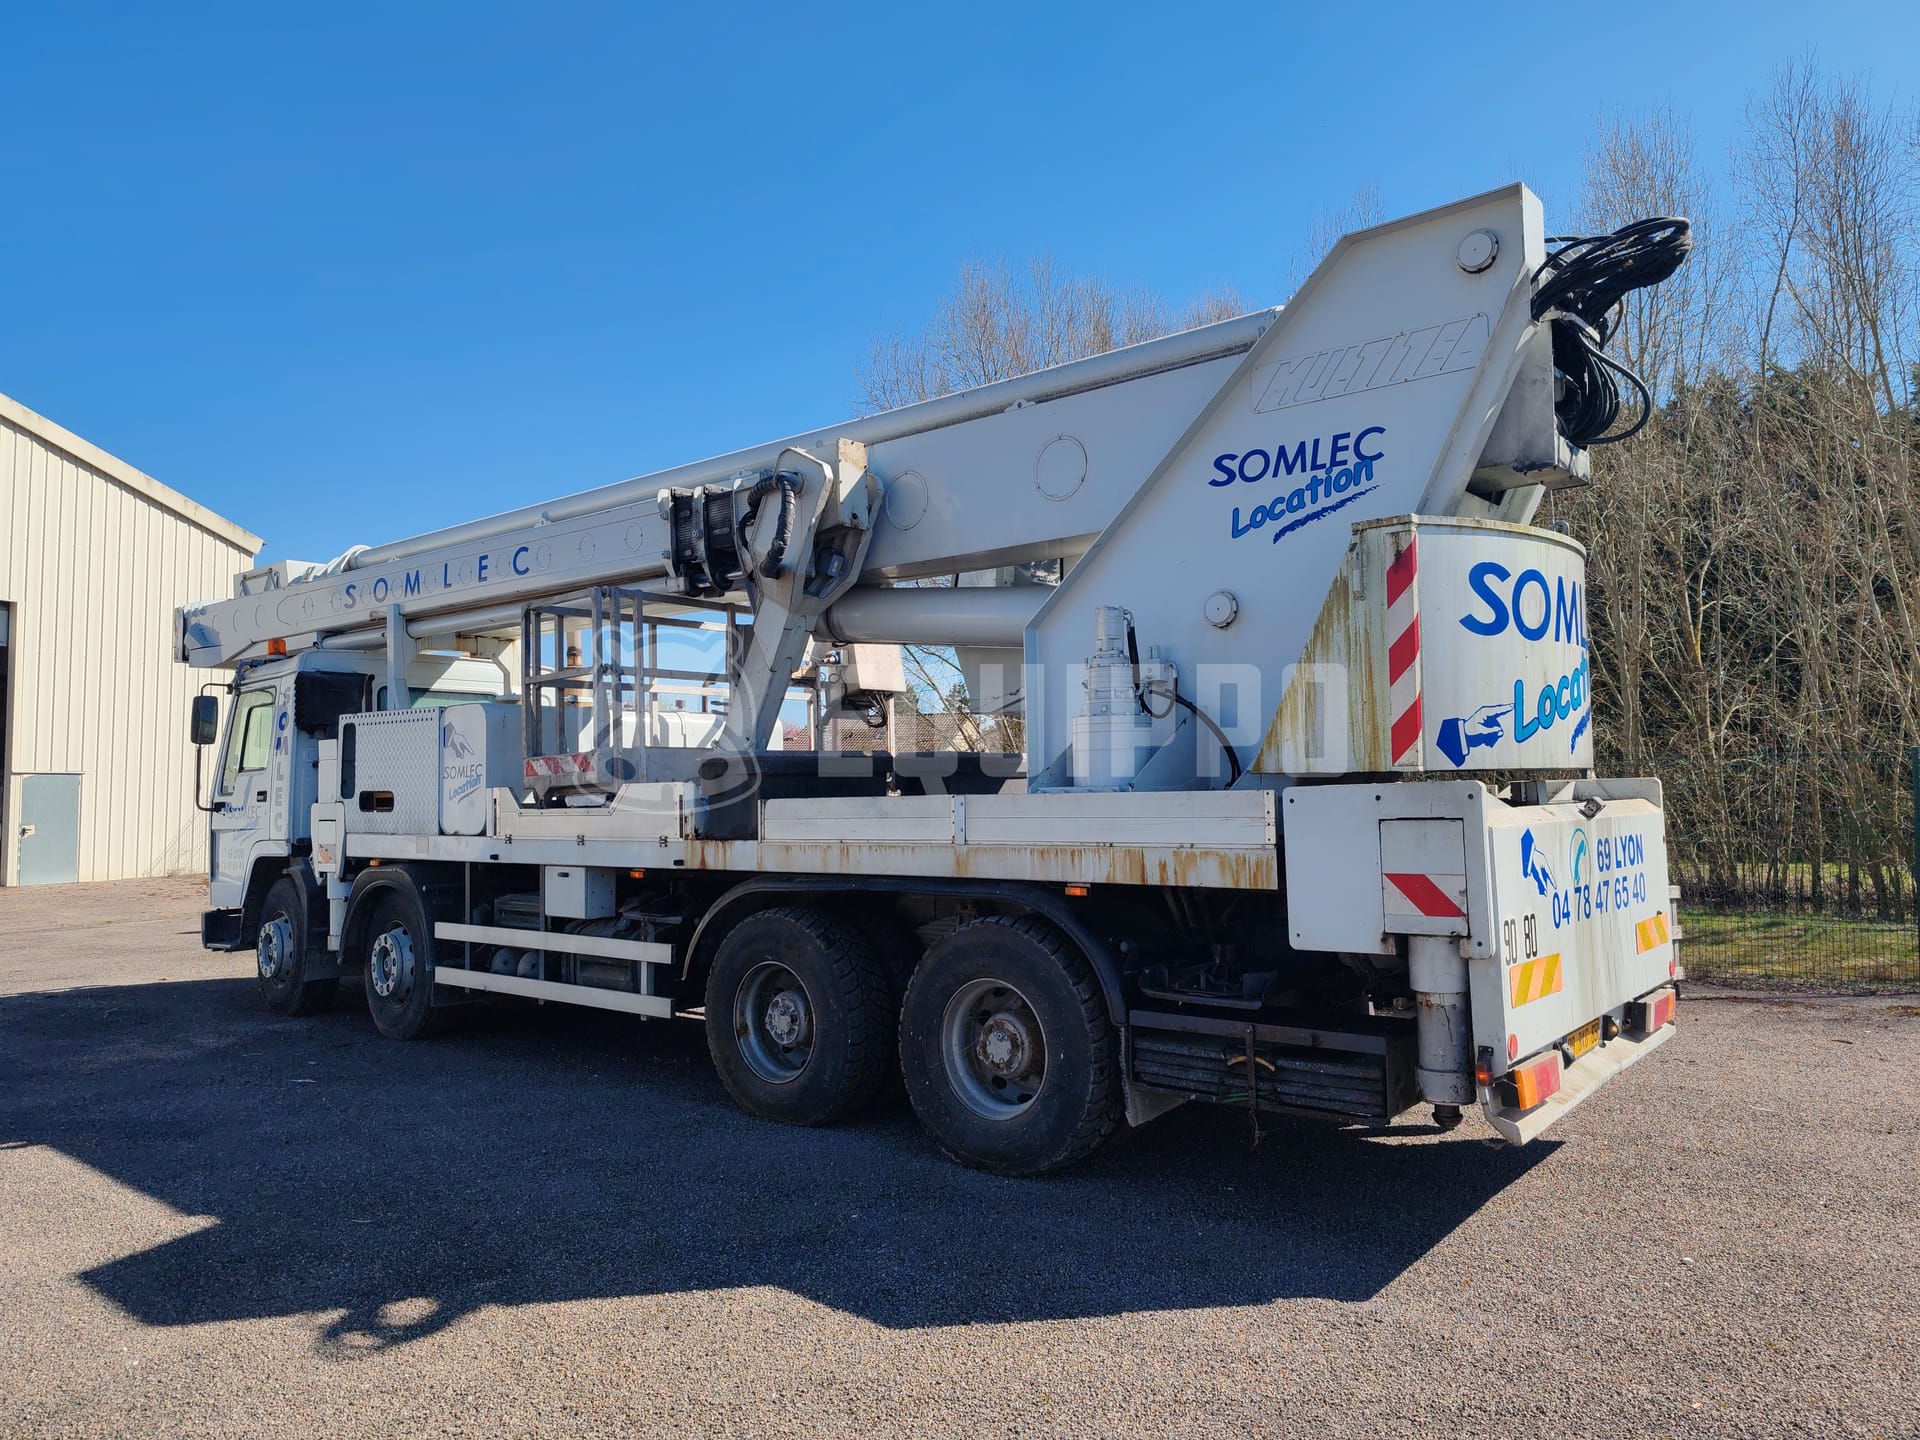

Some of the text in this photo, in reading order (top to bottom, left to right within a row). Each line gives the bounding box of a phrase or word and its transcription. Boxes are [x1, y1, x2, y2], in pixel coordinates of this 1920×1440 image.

[1208, 426, 1387, 488] SOMLEC
[1231, 457, 1375, 538] Location
[344, 546, 530, 609] SOMLEC
[274, 685, 291, 833] SOMLEC
[443, 763, 483, 779] SOMLEC
[1596, 833, 1644, 873] 69 LYON
[1552, 871, 1646, 930] 04 78 47 65 40
[1503, 913, 1538, 966] 90 80
